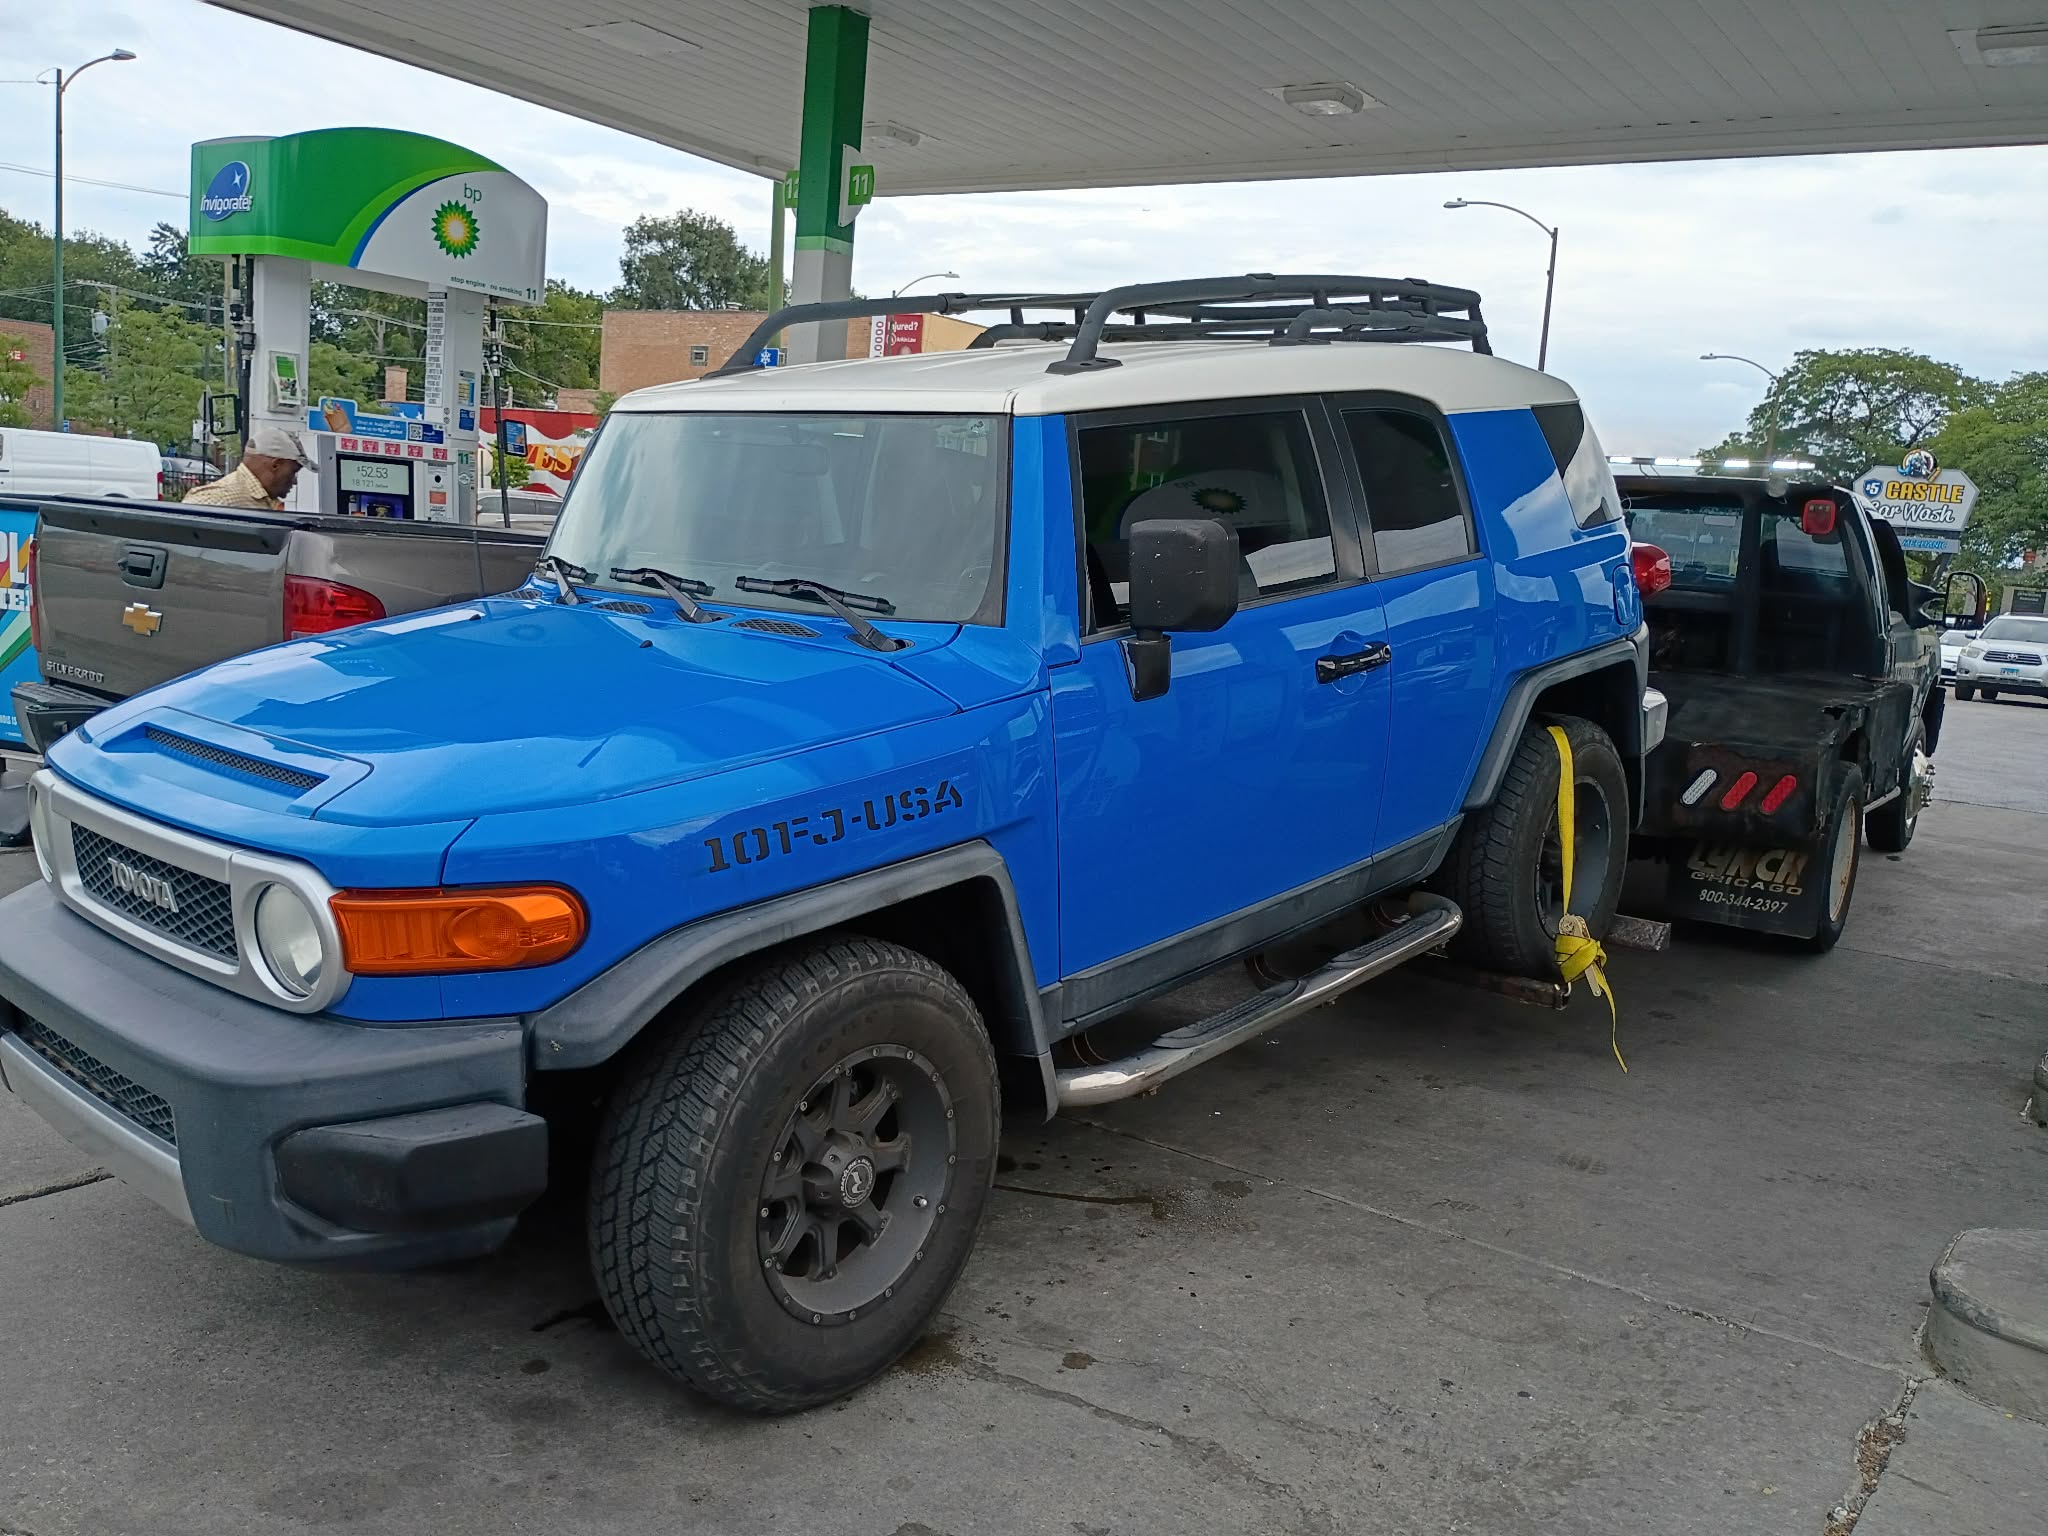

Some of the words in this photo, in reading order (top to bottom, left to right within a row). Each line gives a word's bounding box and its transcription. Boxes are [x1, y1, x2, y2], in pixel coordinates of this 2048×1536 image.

[464, 183, 482, 203] bp
[853, 174, 869, 197] 11
[451, 276, 464, 284] stop
[465, 279, 486, 288] engine
[499, 286, 523, 297] smoking
[526, 287, 537, 301] 11
[458, 452, 469, 465] 11
[1866, 482, 1880, 495] $5
[1885, 480, 1965, 504] CASTLE
[1903, 502, 1956, 524] Wash
[46, 660, 105, 684] SILVERADO
[1687, 846, 1809, 886] LYNCH
[107, 856, 180, 913] TOYOTA
[1691, 871, 1803, 896] CHICAGO
[1699, 888, 1789, 913] 800-344-2397
